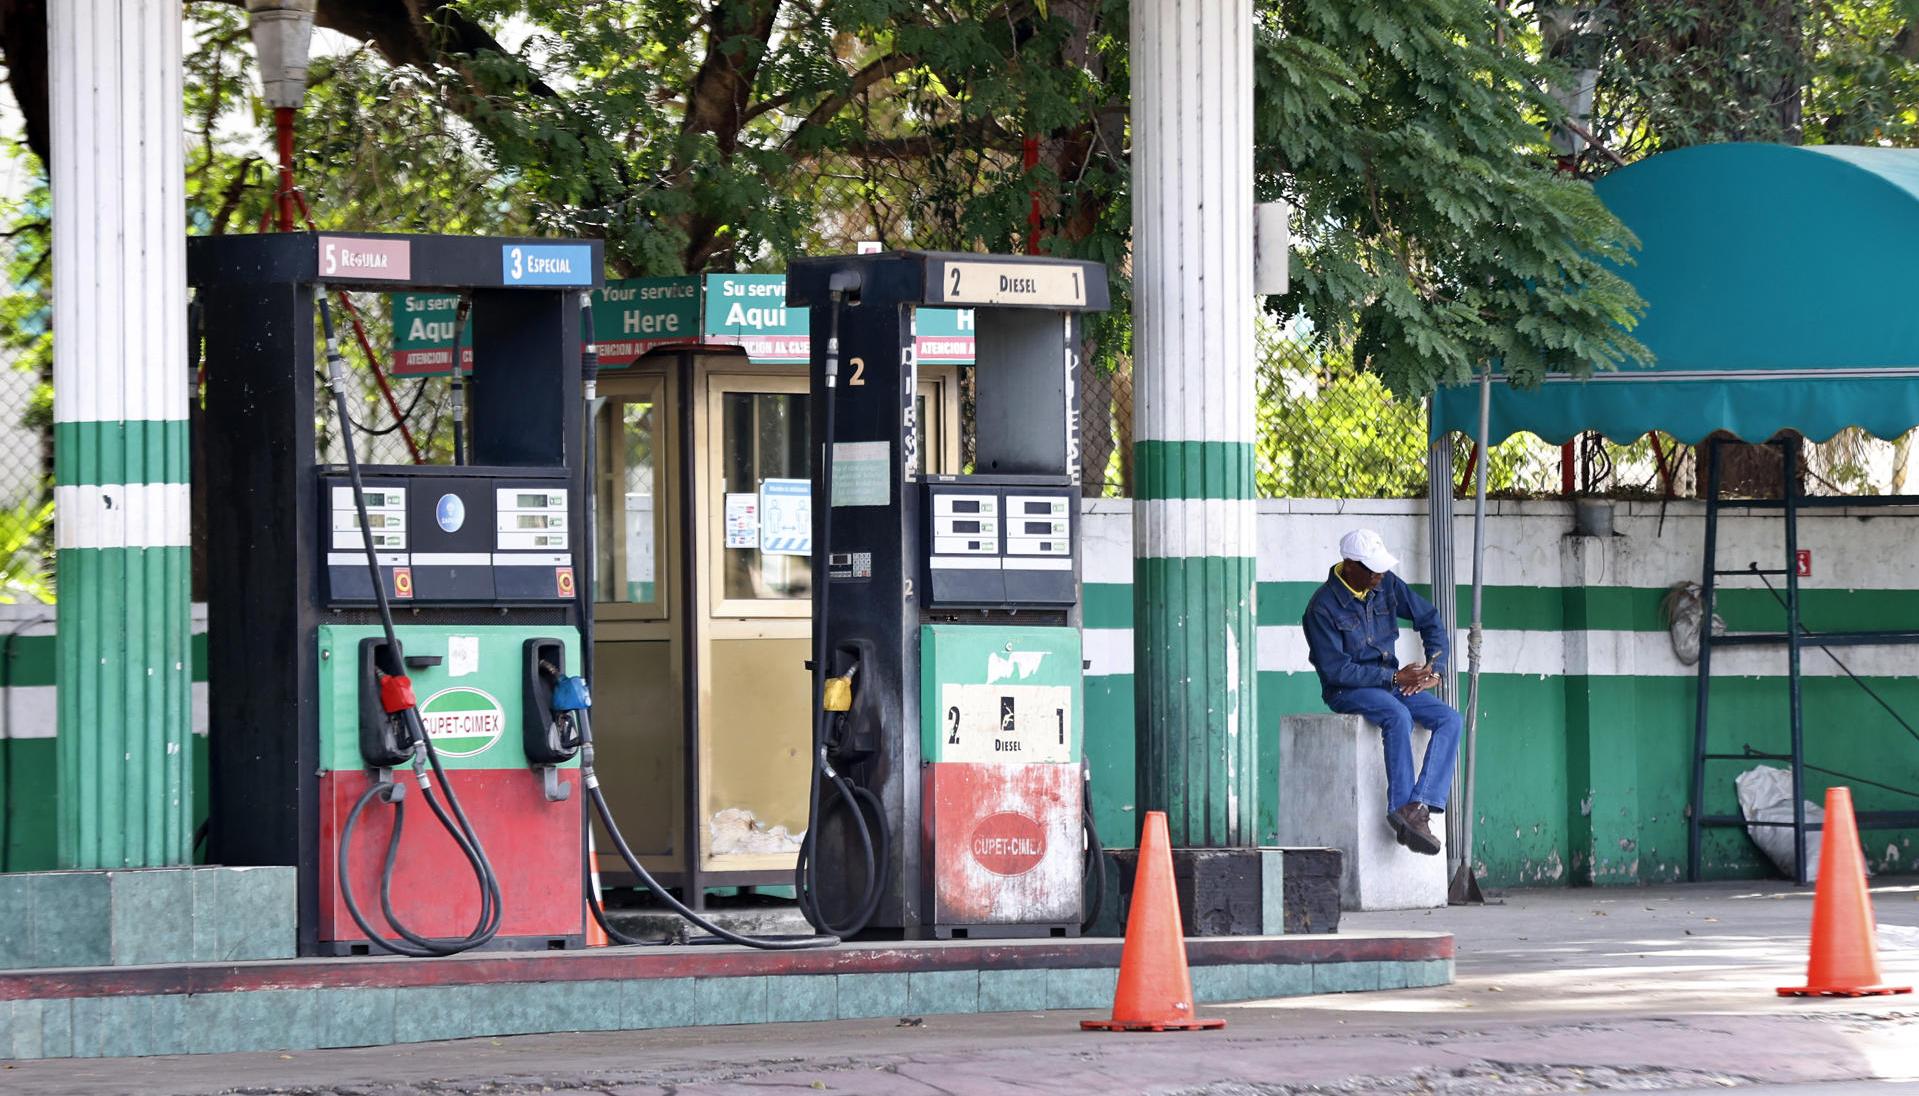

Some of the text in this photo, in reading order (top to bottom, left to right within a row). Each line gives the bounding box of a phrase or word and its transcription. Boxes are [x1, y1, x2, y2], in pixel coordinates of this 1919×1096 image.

[326, 244, 336, 274] 5
[511, 248, 571, 279] 3 ESPECIAL
[602, 282, 695, 302] Your service
[723, 280, 744, 297] Su
[950, 268, 1080, 299] 2 DIESEL 1
[405, 296, 424, 312] Su
[725, 301, 787, 330] Aquí
[407, 317, 455, 343] Aqu
[623, 310, 679, 334] Here
[849, 357, 865, 386] 2
[904, 579, 914, 596] 2
[948, 706, 1064, 745] 2 1
[995, 739, 1022, 751] DIESEL
